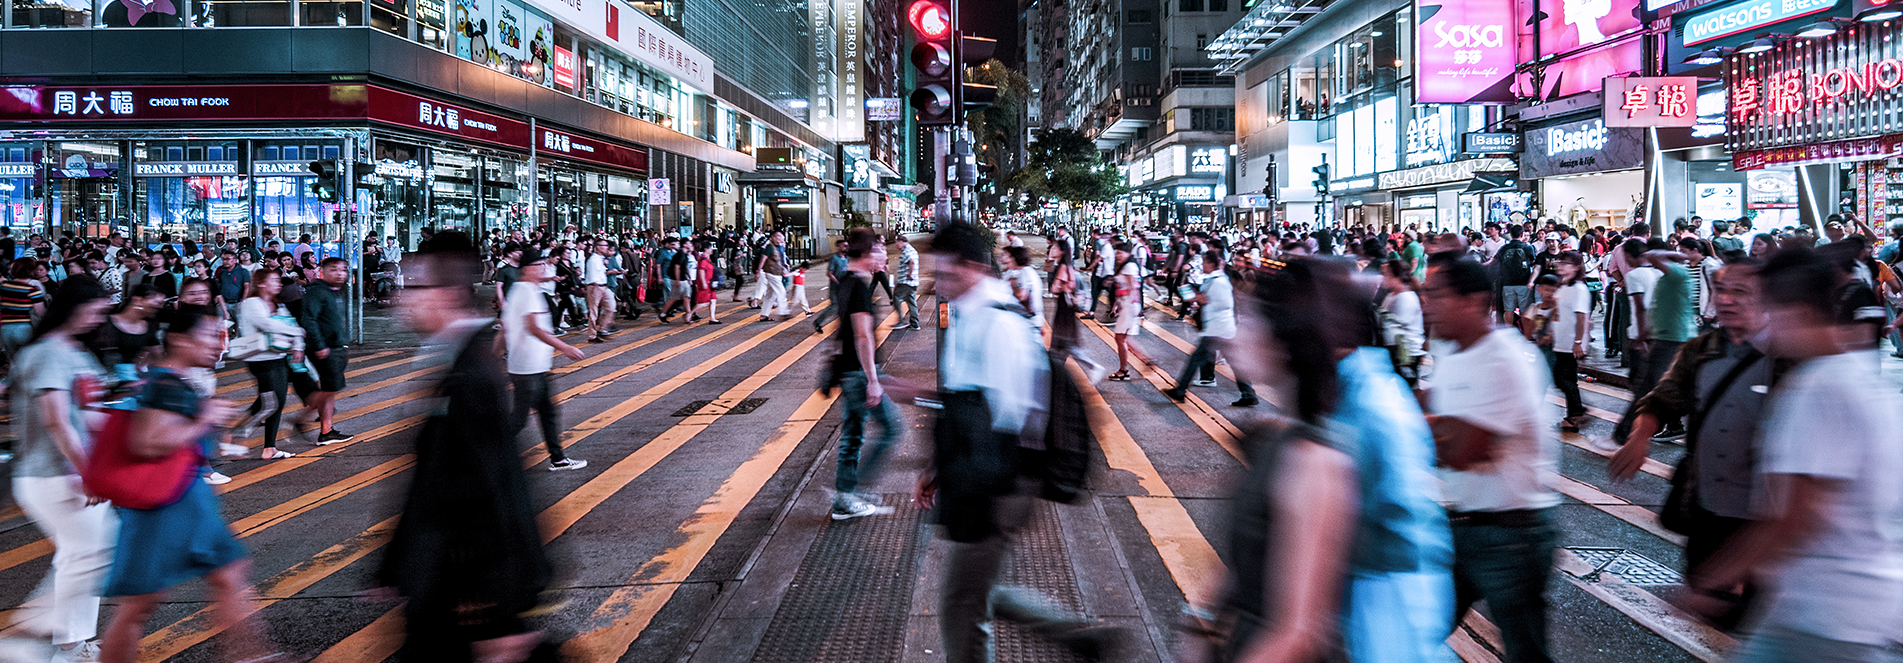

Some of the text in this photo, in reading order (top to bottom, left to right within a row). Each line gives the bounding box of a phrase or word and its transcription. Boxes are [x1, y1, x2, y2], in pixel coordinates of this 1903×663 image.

[1652, 17, 1670, 31] JM
[1692, 2, 1771, 38] watsons
[847, 2, 857, 58] EMPEROR
[557, 51, 573, 71] 周大
[1810, 58, 1903, 101] BONJO
[53, 90, 230, 115] 周大福 CHOW TAI FOOK
[419, 101, 459, 130] 周大福
[255, 163, 303, 173] FRANCK
[1559, 159, 1579, 168] design
[1739, 154, 1765, 168] SALE
[0, 165, 36, 175] ULLER
[136, 163, 236, 174] FRANCK MULLER
[1176, 186, 1211, 195] RADO
